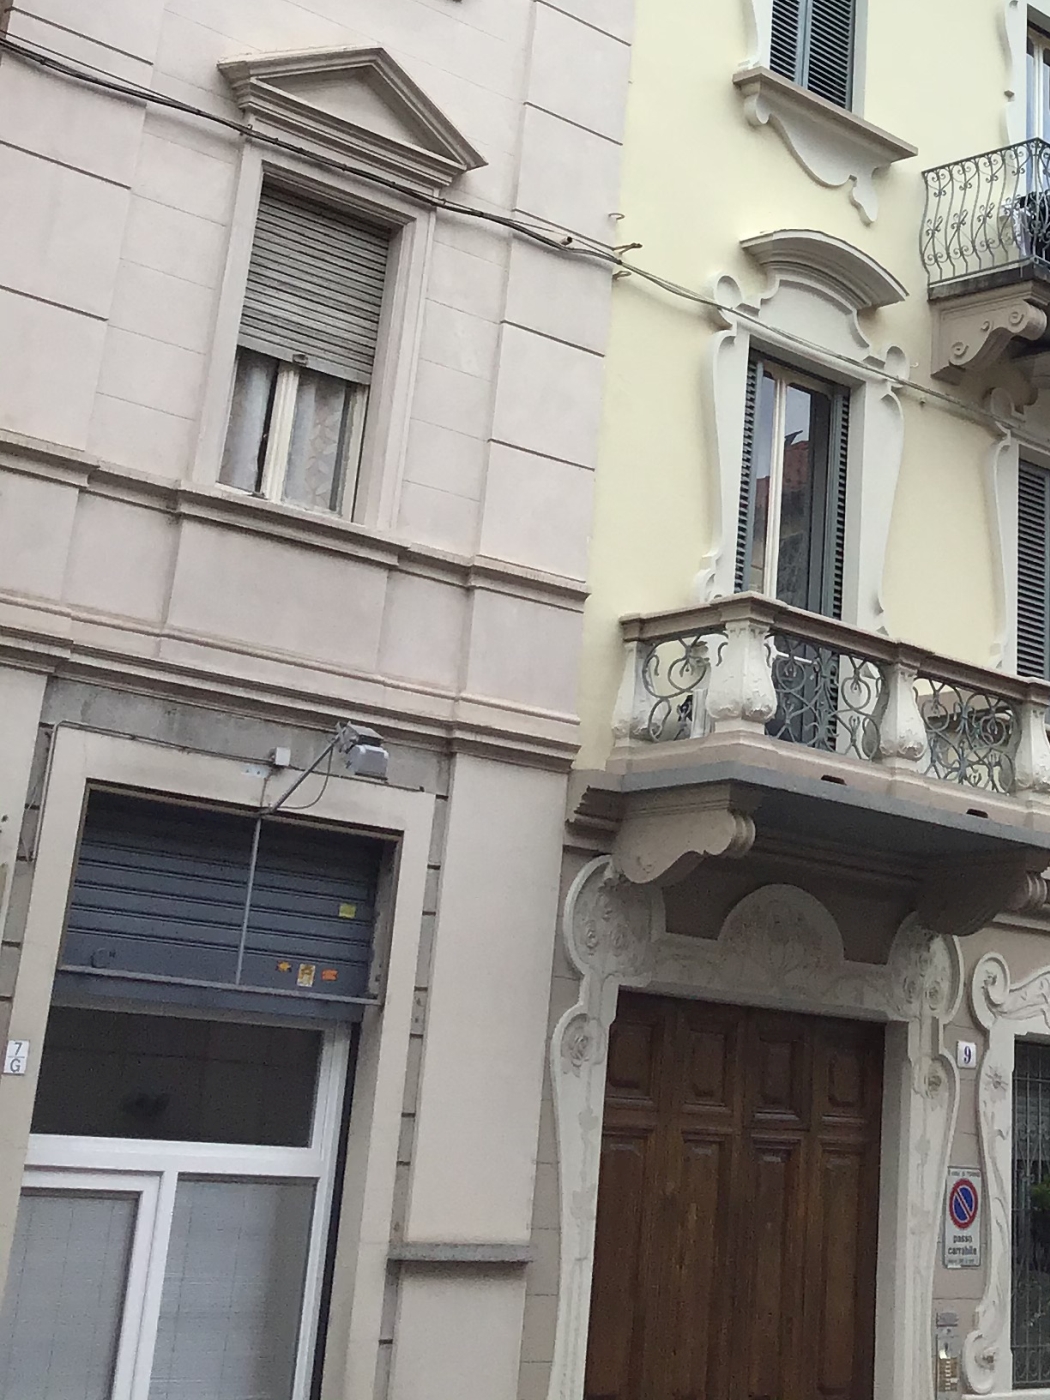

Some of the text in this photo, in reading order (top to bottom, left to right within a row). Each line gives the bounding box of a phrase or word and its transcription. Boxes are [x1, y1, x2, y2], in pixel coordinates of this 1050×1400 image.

[14, 1041, 23, 1056] 7
[963, 1045, 972, 1065] 9
[10, 1058, 21, 1073] G
